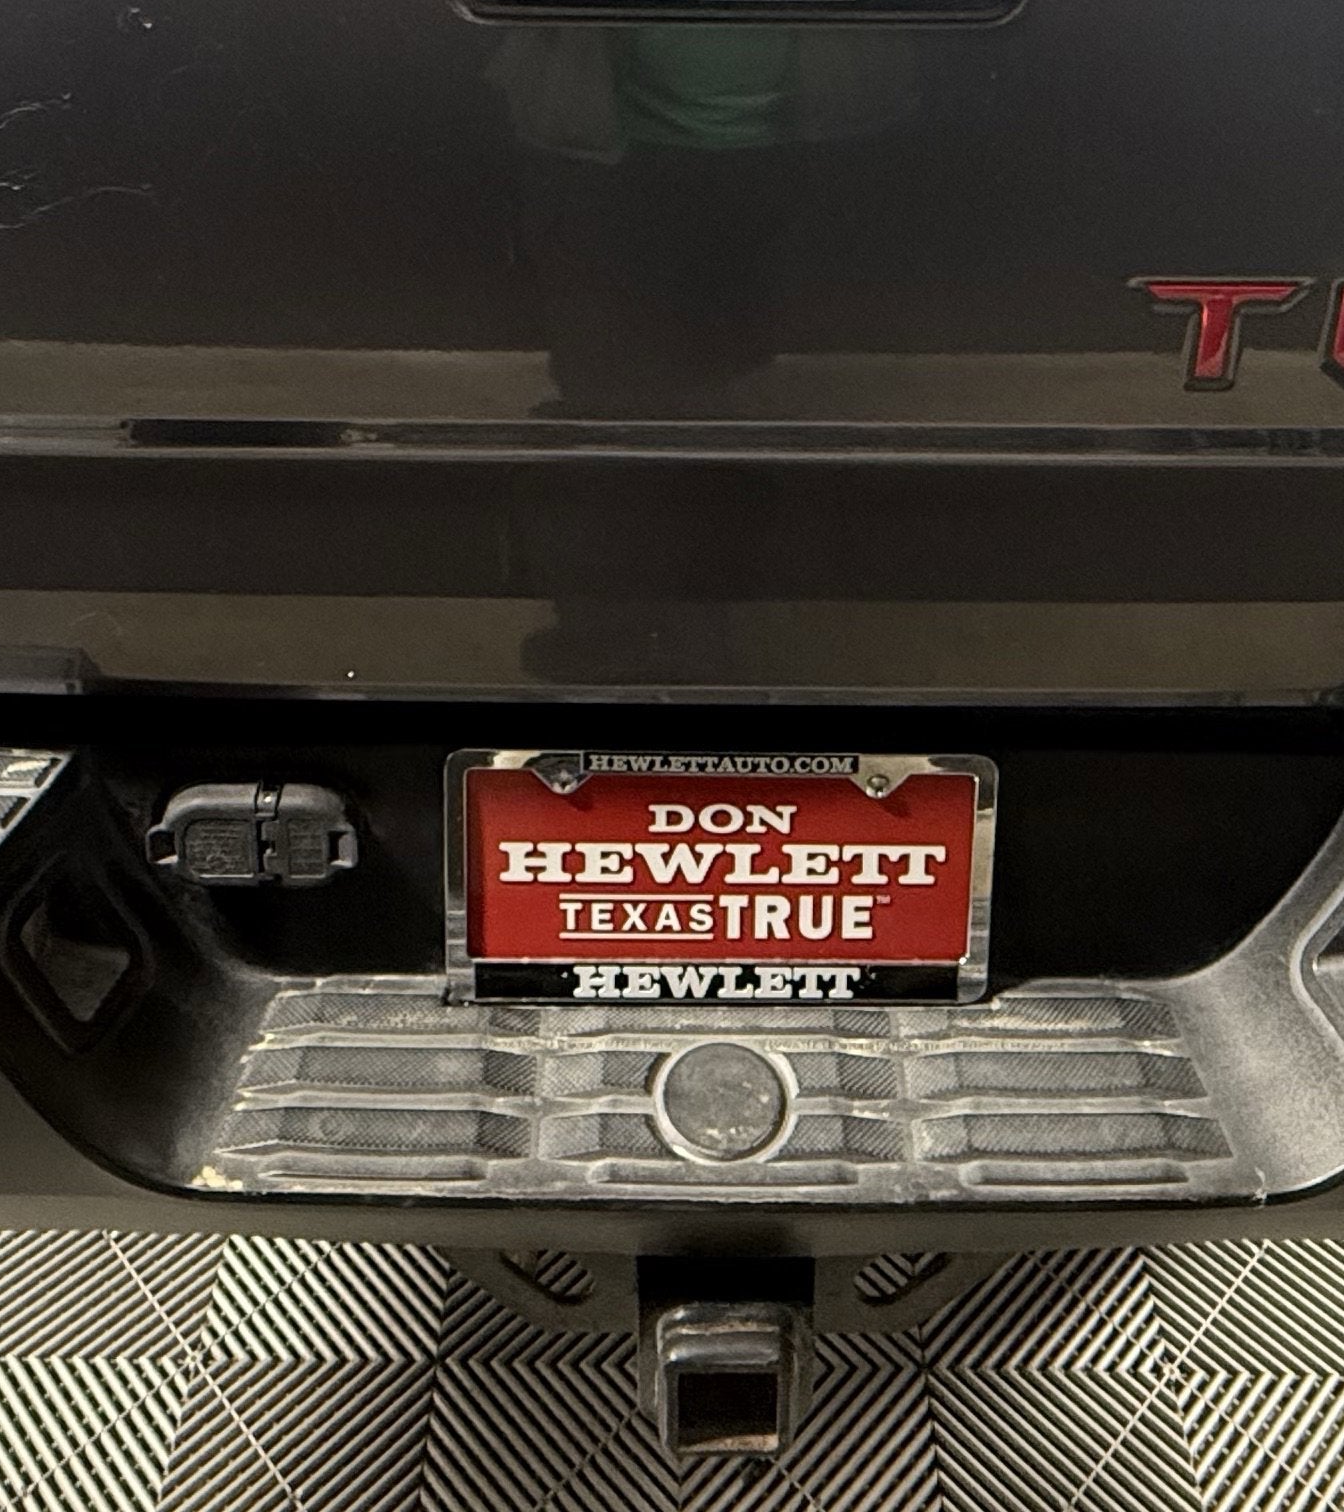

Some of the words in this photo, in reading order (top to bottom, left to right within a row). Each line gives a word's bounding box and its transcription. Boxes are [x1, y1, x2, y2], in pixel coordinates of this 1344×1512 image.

[588, 754, 854, 775] HEWLETTAUTO.COM
[648, 803, 797, 835] DON
[498, 841, 946, 885] HEWLETT
[573, 965, 861, 999] HEWLETT
